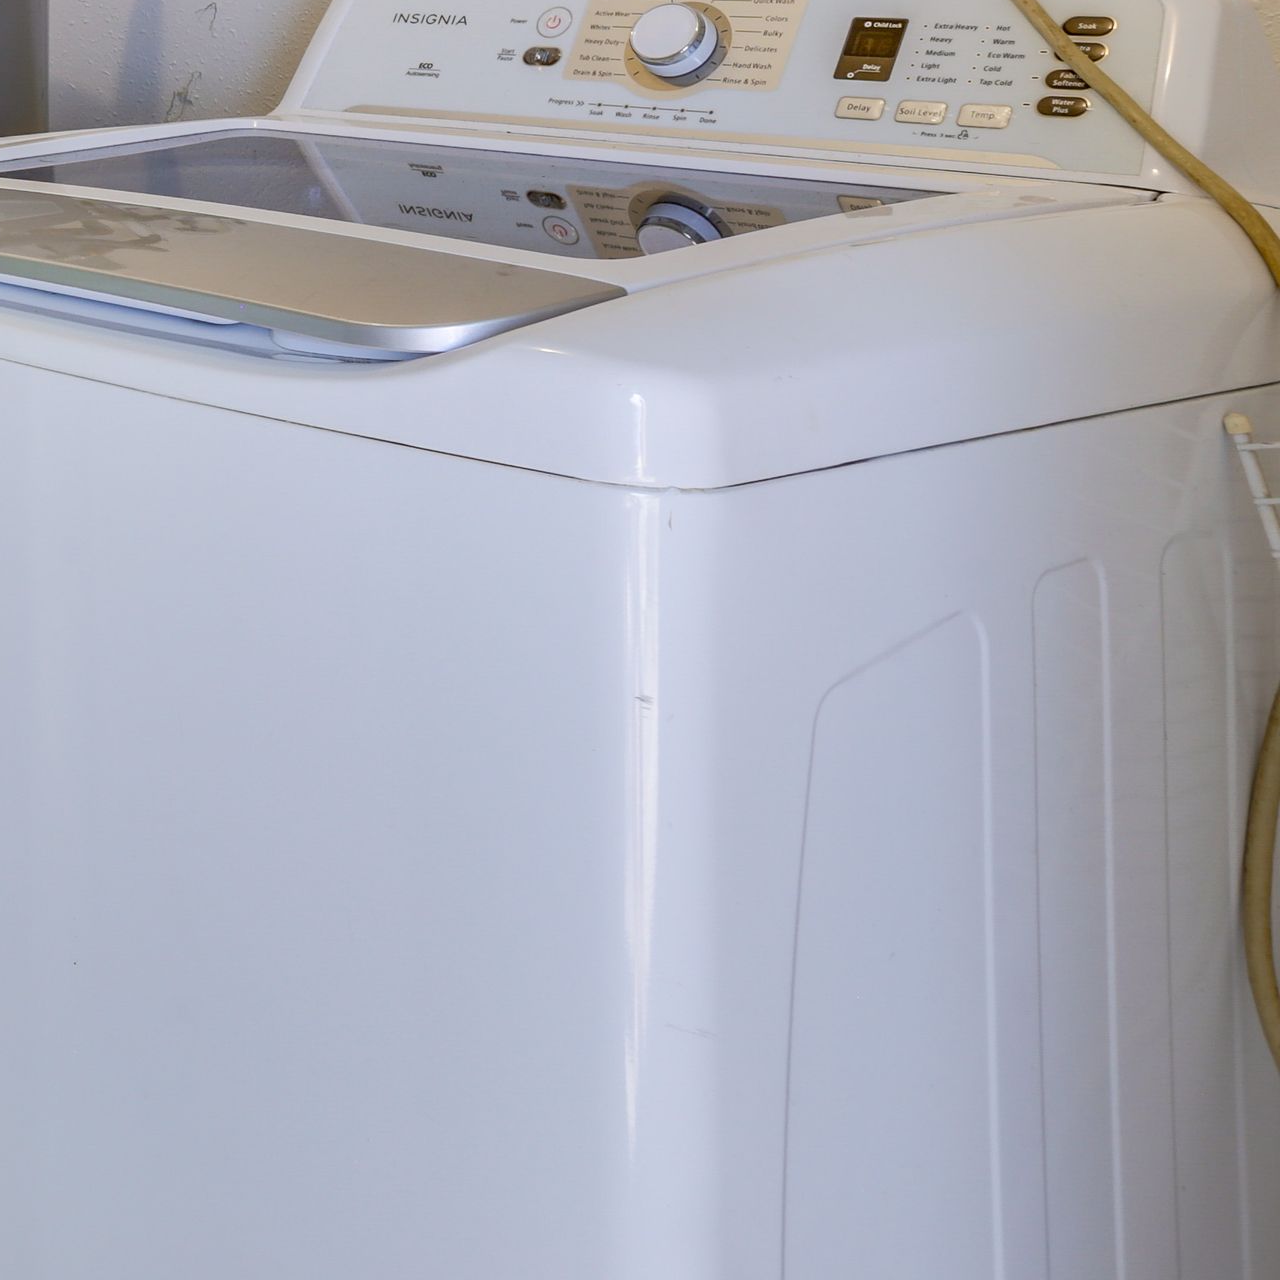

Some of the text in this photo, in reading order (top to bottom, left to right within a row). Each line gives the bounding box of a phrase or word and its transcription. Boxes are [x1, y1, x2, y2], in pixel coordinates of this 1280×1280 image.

[392, 13, 468, 26] INSIGNIA
[955, 24, 978, 32] Heavy
[1078, 22, 1097, 30] Soak
[763, 30, 783, 38] Bulky
[604, 38, 620, 46] Duty
[930, 36, 953, 44] Heavy
[744, 45, 778, 53] Delicates
[862, 63, 881, 71] Delay
[750, 78, 767, 86] Spin
[937, 76, 957, 84] Light
[847, 103, 871, 113] Delay
[918, 108, 942, 117] Level
[970, 111, 995, 120] Temp
